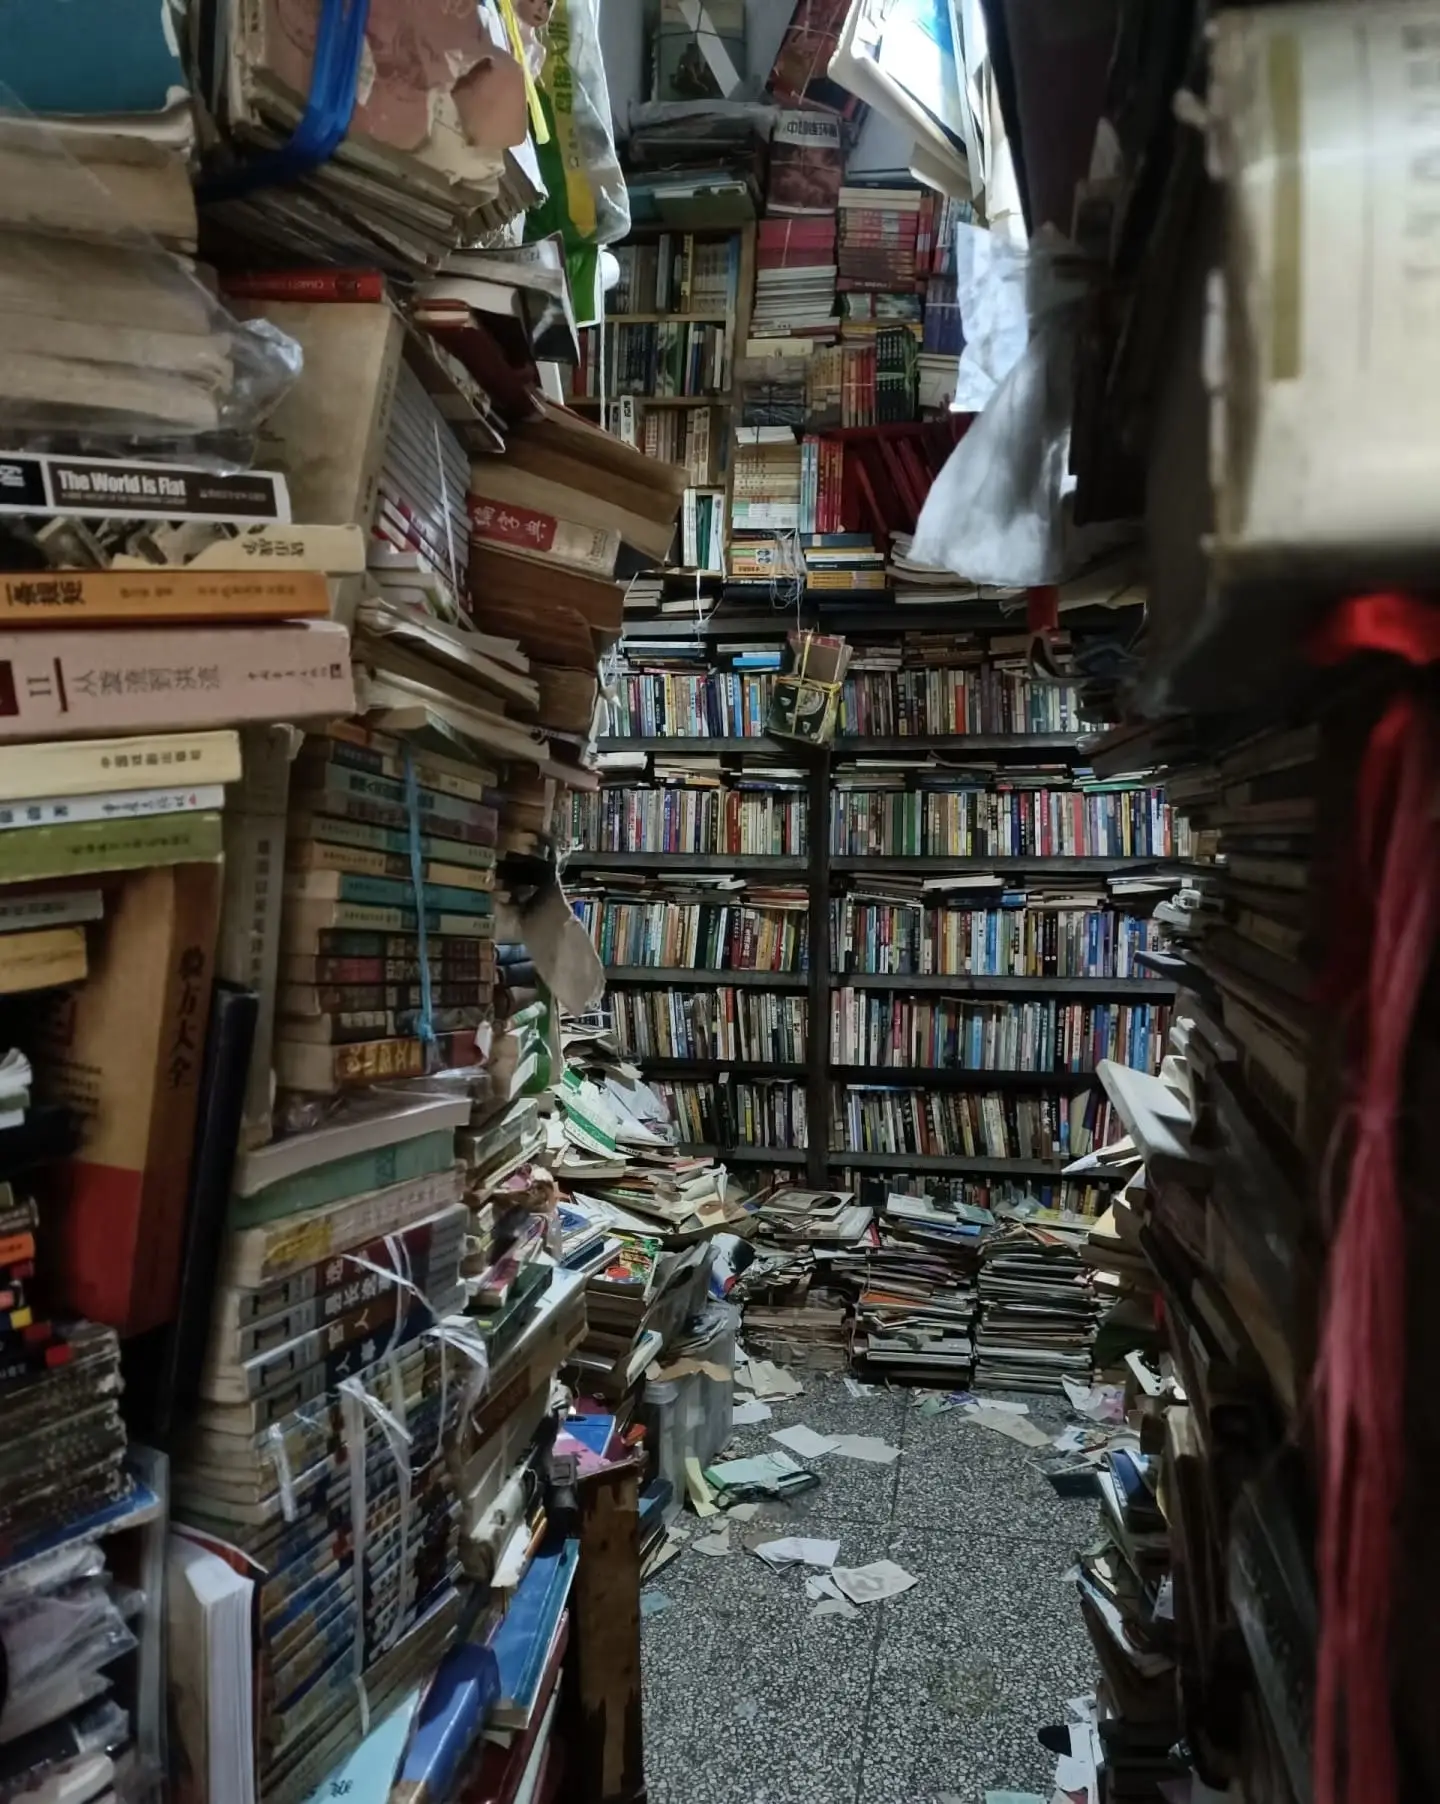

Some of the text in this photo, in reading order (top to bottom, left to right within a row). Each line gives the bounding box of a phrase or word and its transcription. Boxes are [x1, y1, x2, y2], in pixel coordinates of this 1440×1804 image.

[57, 470, 90, 490] The
[90, 472, 140, 494] World
[158, 476, 187, 496] Flat
